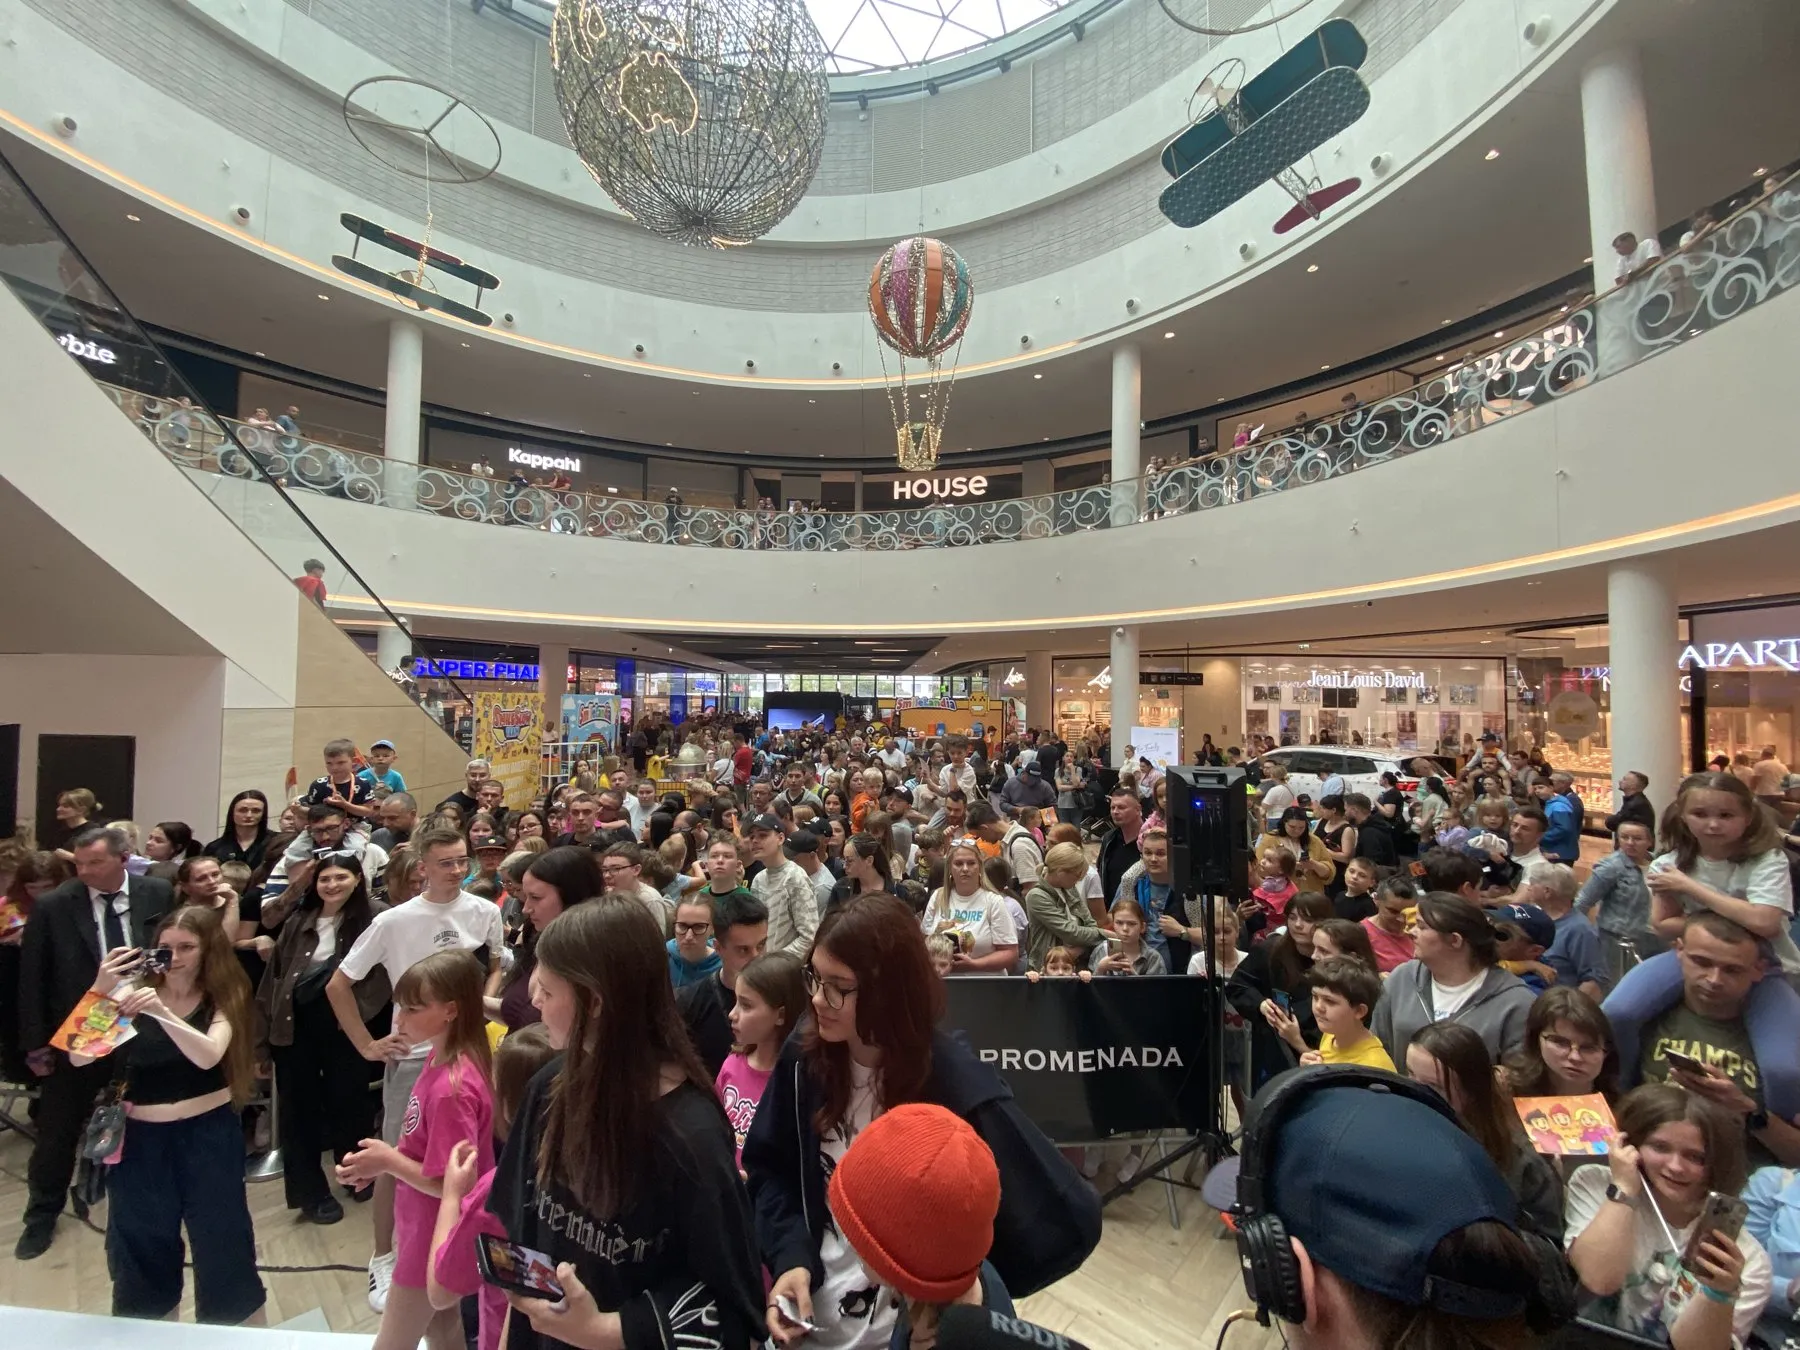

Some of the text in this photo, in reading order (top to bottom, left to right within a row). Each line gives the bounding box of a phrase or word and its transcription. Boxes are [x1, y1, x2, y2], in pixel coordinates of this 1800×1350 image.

[508, 447, 580, 472] Kappahl
[1679, 638, 1800, 671] APART
[1308, 670, 1425, 688] Jean Louis David
[979, 1046, 1184, 1073] PROMENADA
[1653, 1038, 1757, 1089] CHAMPS
